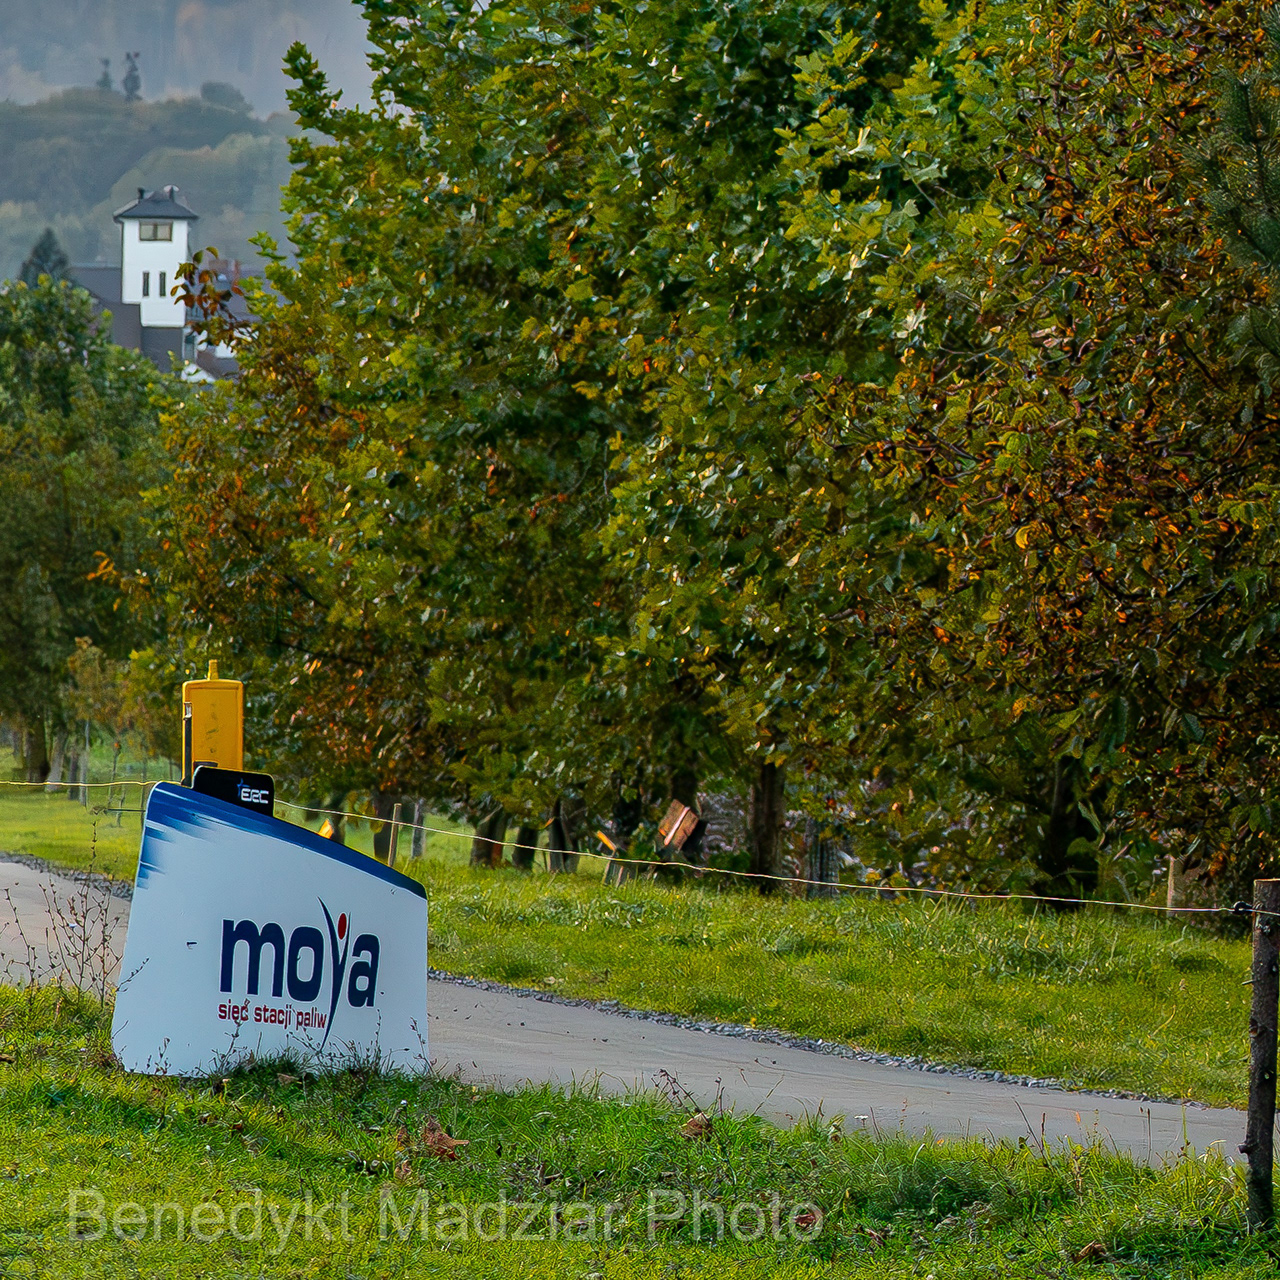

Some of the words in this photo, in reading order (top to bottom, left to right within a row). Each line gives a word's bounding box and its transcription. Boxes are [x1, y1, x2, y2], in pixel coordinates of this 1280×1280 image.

[219, 895, 380, 1053] moya
[253, 1003, 293, 1030] stacji
[295, 1006, 328, 1031] paliw
